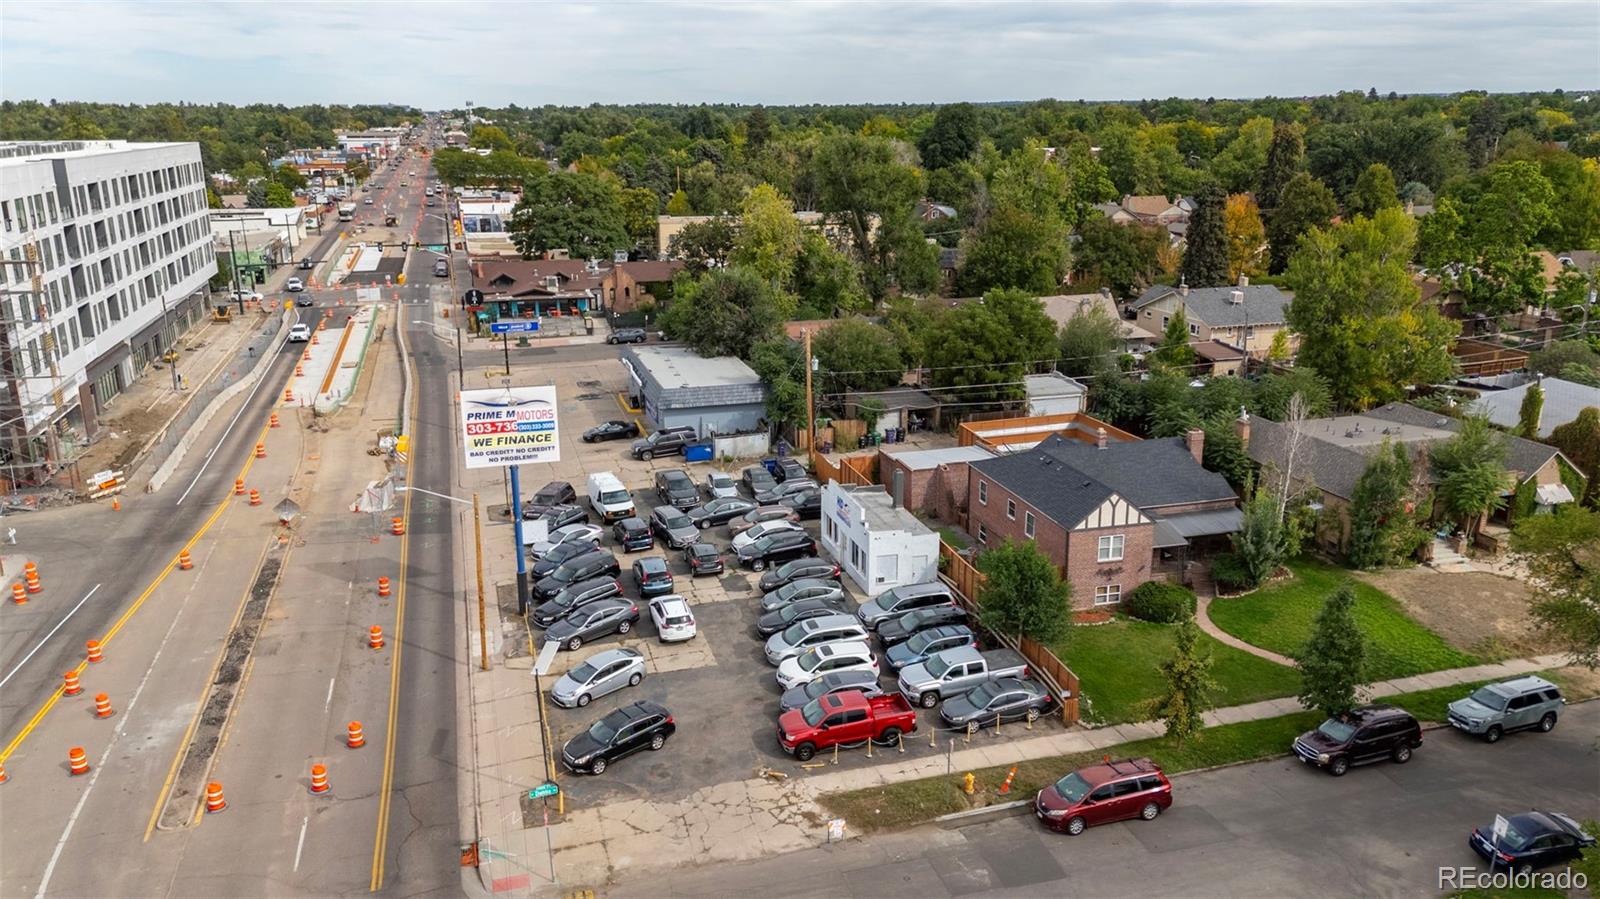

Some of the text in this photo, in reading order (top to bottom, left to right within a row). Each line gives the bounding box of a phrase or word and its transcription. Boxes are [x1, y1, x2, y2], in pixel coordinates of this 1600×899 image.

[467, 409, 554, 420] PRIME M MOTORS
[468, 421, 518, 434] 303-736
[473, 434, 552, 447] WE FINANCE
